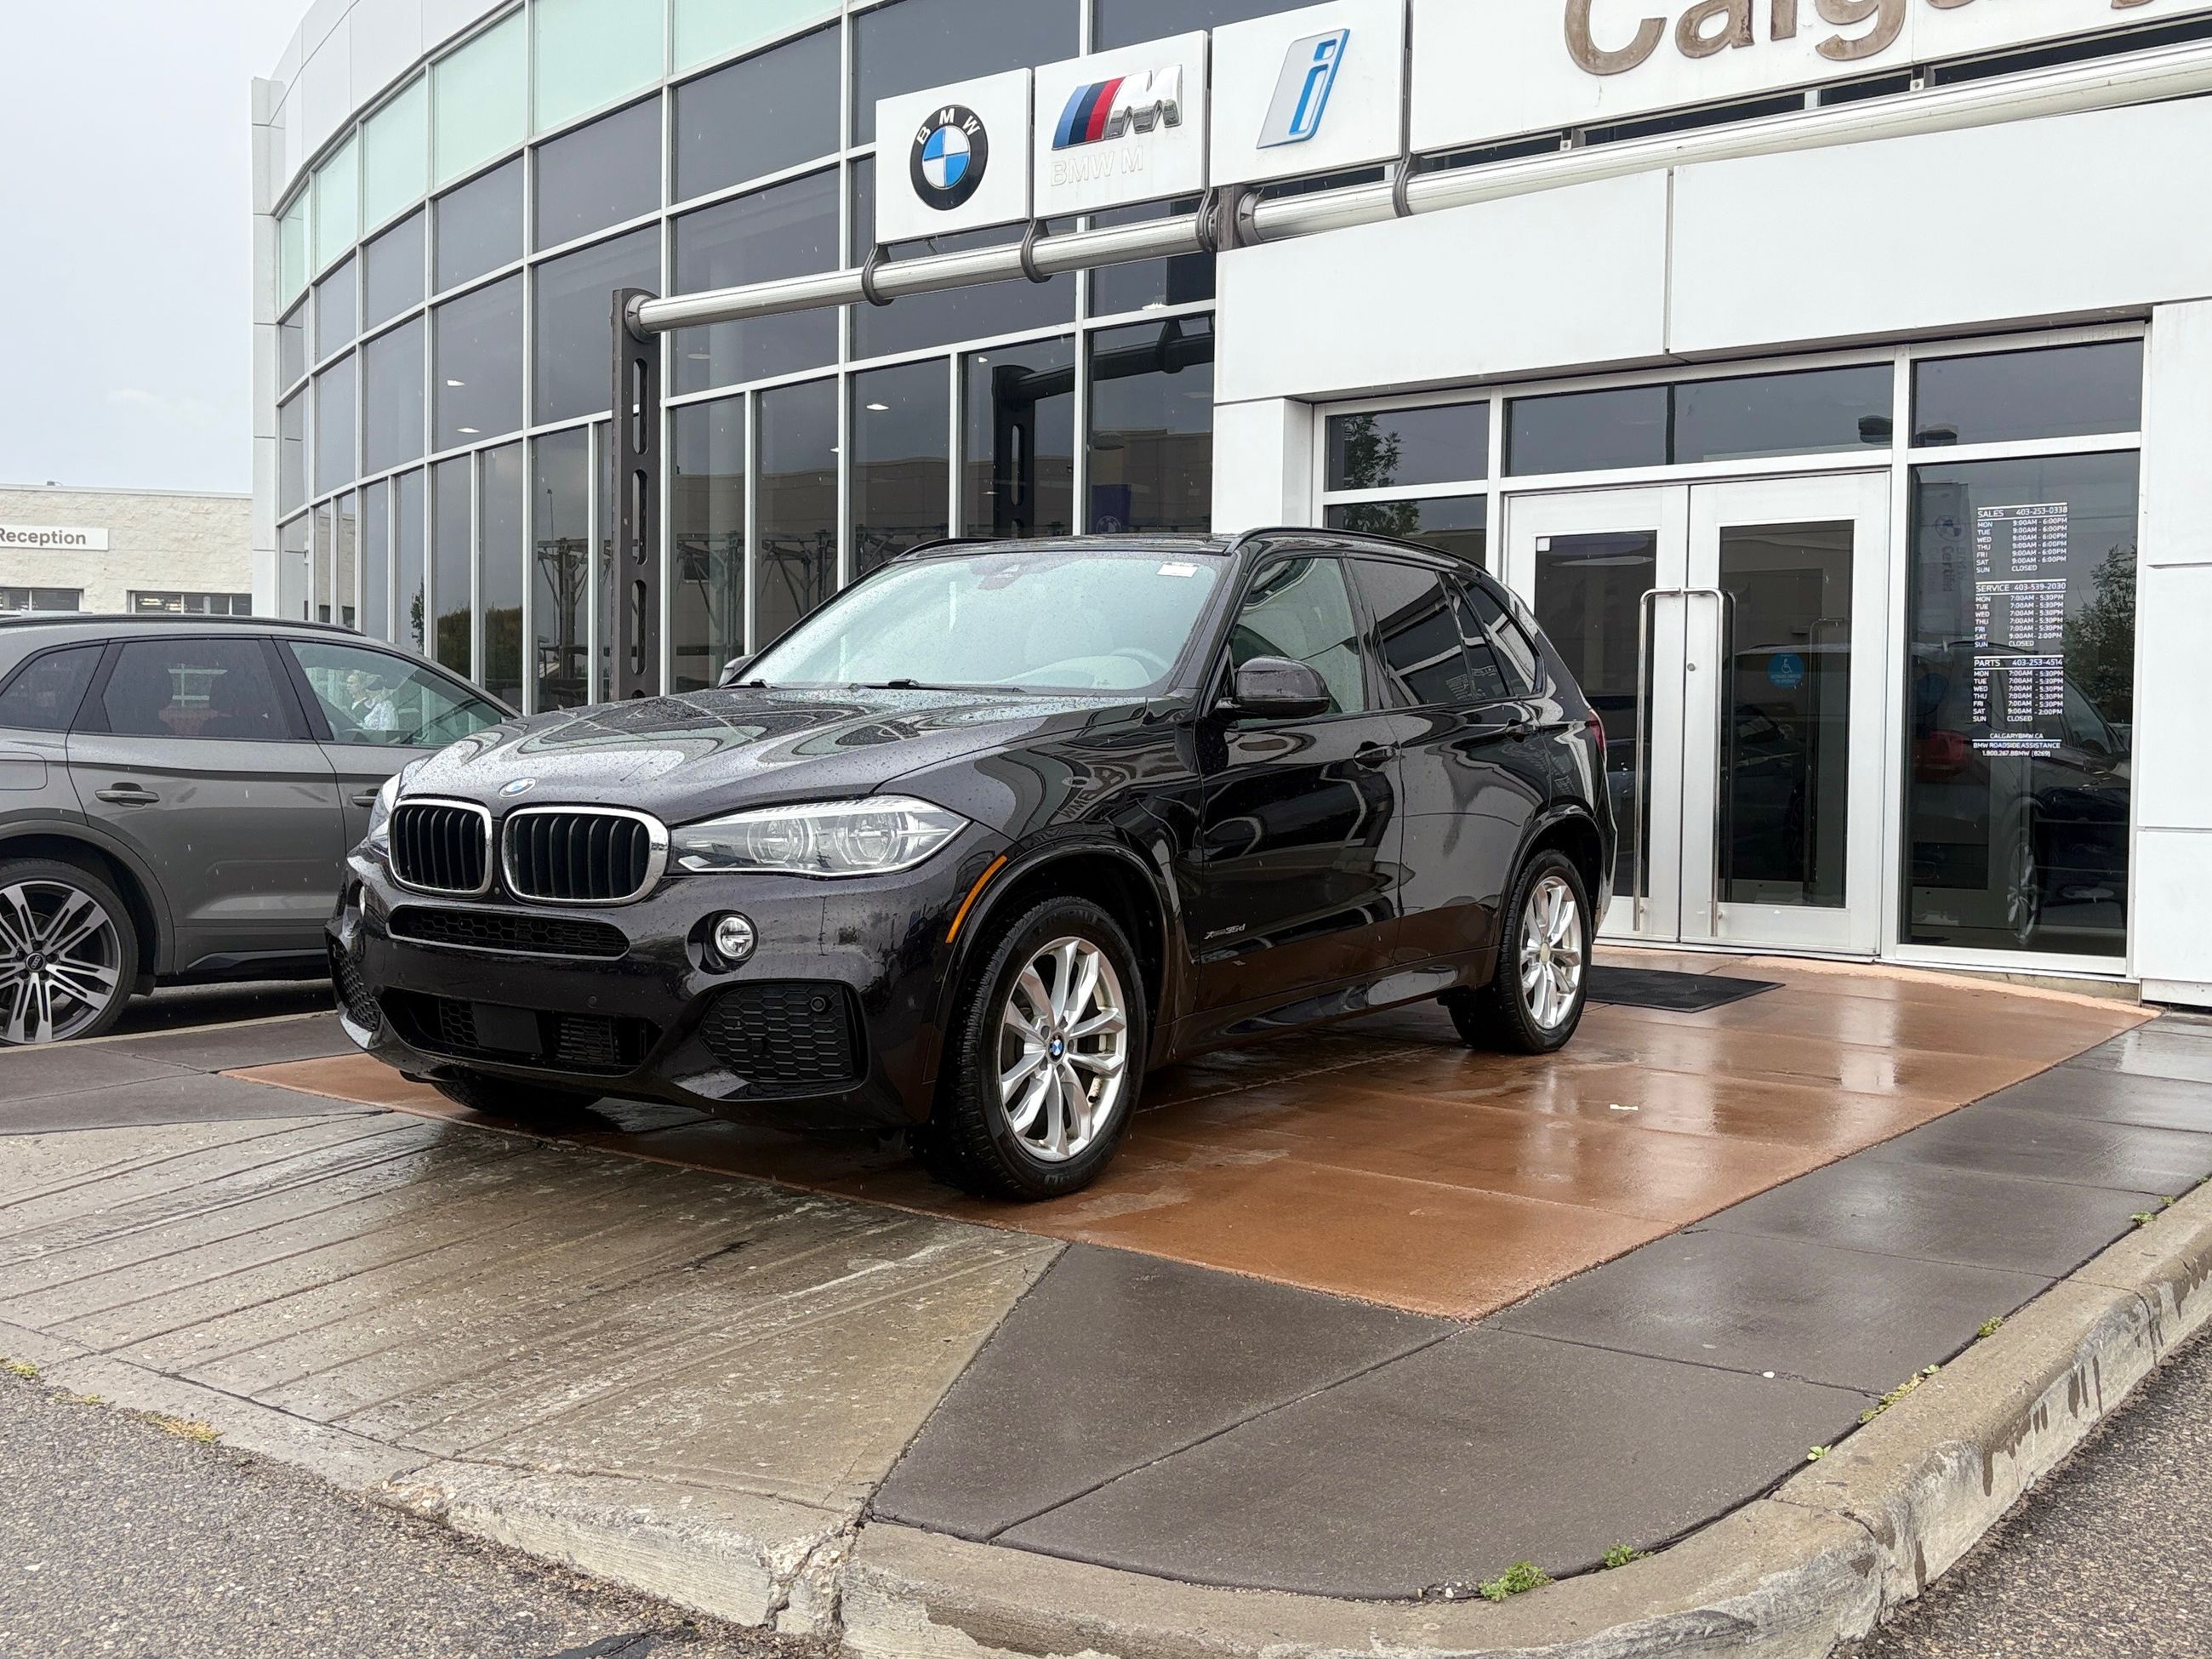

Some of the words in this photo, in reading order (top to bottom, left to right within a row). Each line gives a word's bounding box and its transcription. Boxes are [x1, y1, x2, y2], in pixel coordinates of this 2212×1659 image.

[916, 107, 981, 145] BMW
[1051, 151, 1115, 186] BMW
[1122, 145, 1143, 174] M
[1977, 510, 2004, 518] SALES
[2015, 506, 2068, 516] 403-253-0338
[1975, 584, 2010, 593] SERVICE
[2014, 582, 2067, 590] 403-539-2030
